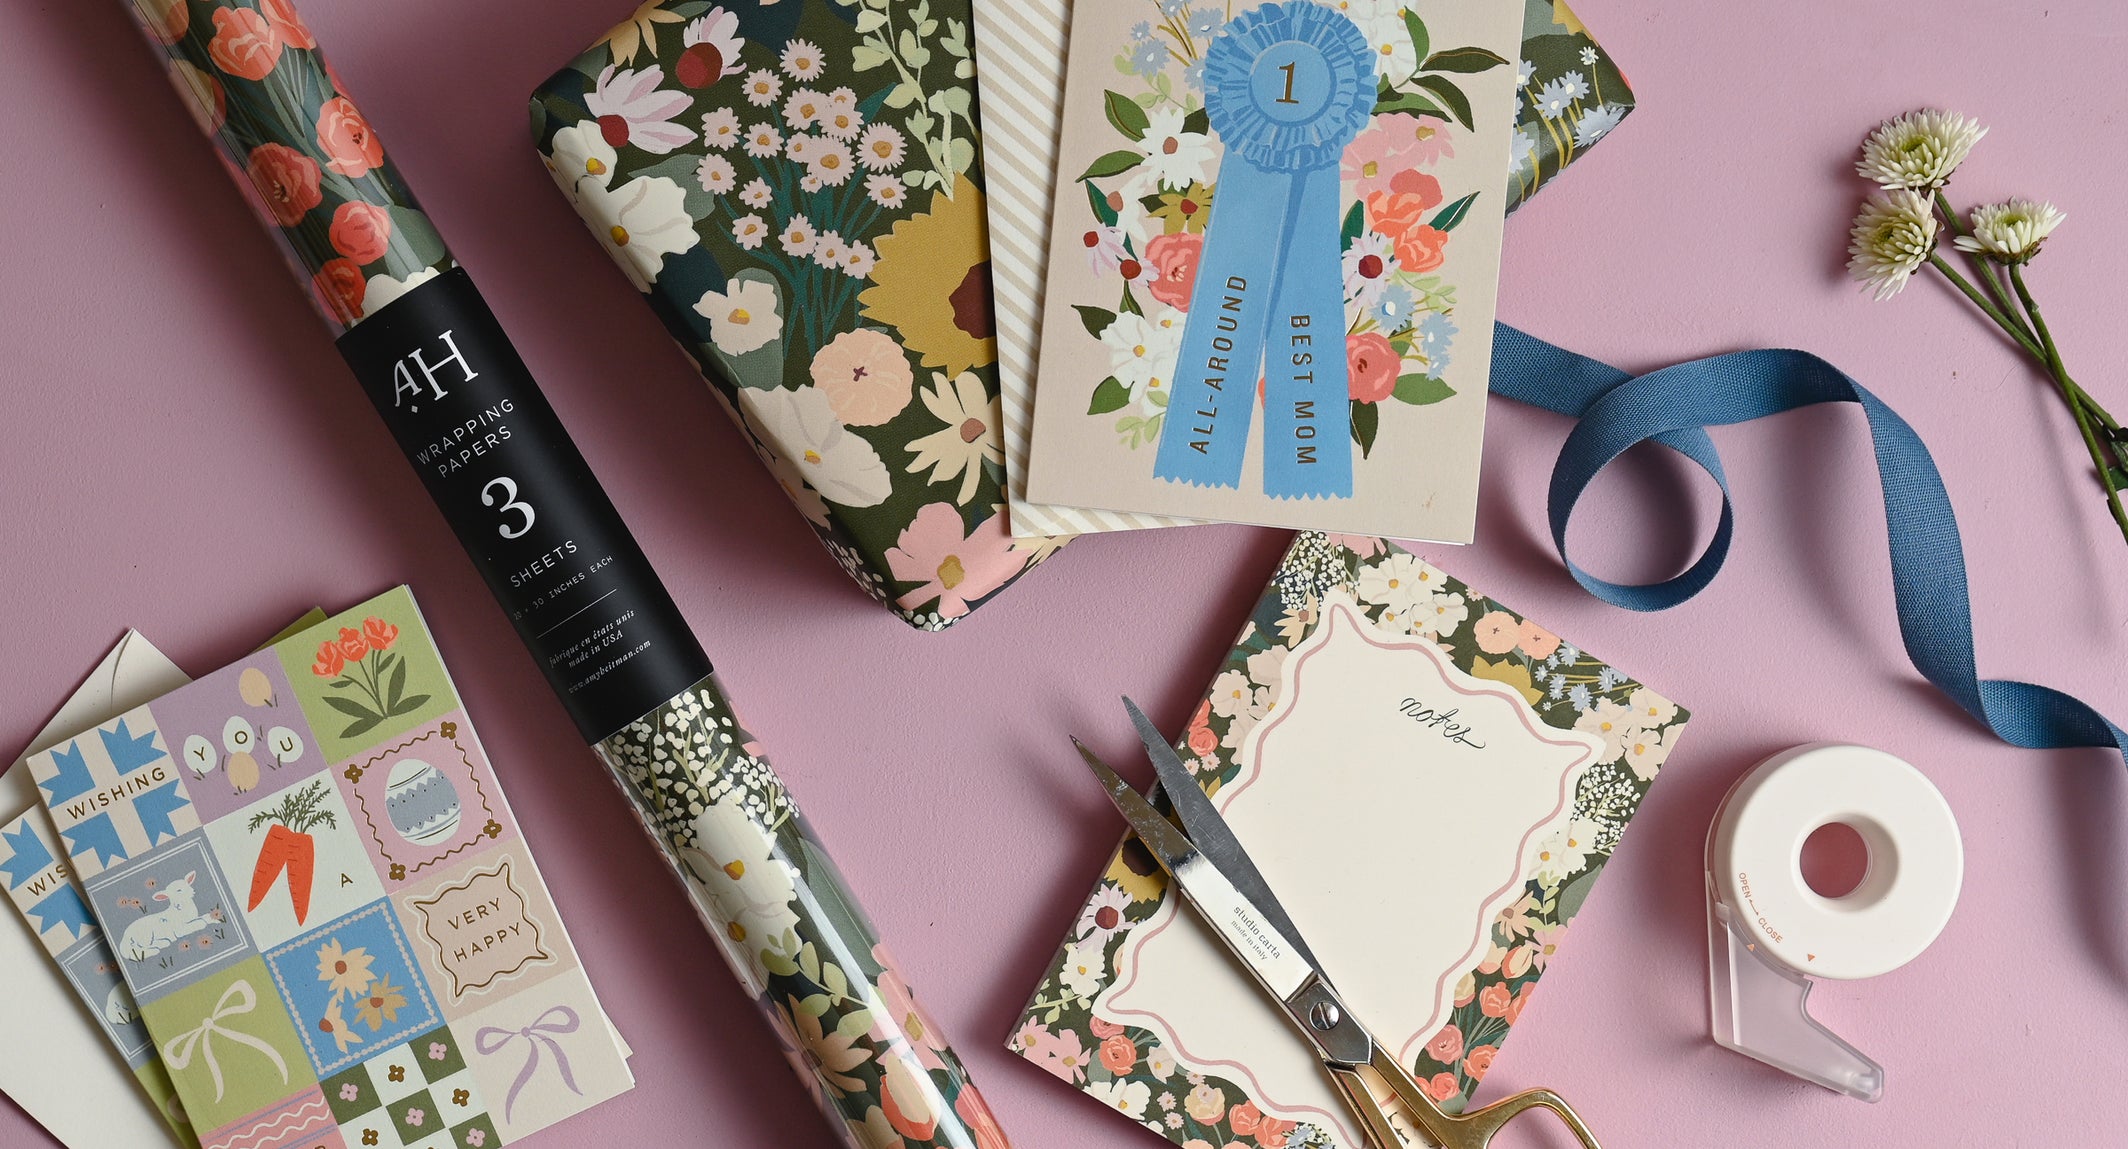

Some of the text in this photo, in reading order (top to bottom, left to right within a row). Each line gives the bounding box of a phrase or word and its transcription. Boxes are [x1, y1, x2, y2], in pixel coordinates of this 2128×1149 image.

[1275, 61, 1299, 104] 1
[1189, 276, 1247, 455] ALL-AROUND
[1290, 315, 1317, 464] BEST MOM
[416, 398, 514, 465] WRAPPING
[438, 425, 512, 478] PAPERS
[481, 476, 536, 540] 3
[510, 540, 578, 588] SHEETS
[532, 597, 545, 609] 30
[549, 572, 586, 599] INCHES
[589, 555, 614, 573] EACH
[548, 643, 579, 669] fabrique
[580, 636, 591, 648] en
[615, 609, 634, 626] unis
[568, 628, 623, 669] made in USA
[1399, 696, 1486, 750] notes
[66, 766, 166, 820] WISHING
[26, 863, 69, 897] WIS
[340, 872, 354, 888] A
[447, 897, 501, 931] VERY
[1233, 906, 1281, 960] studio carta
[1738, 872, 1783, 944] OPEN CLOSE
[453, 922, 521, 963] HAPPY
[1231, 920, 1268, 961] made in italy
